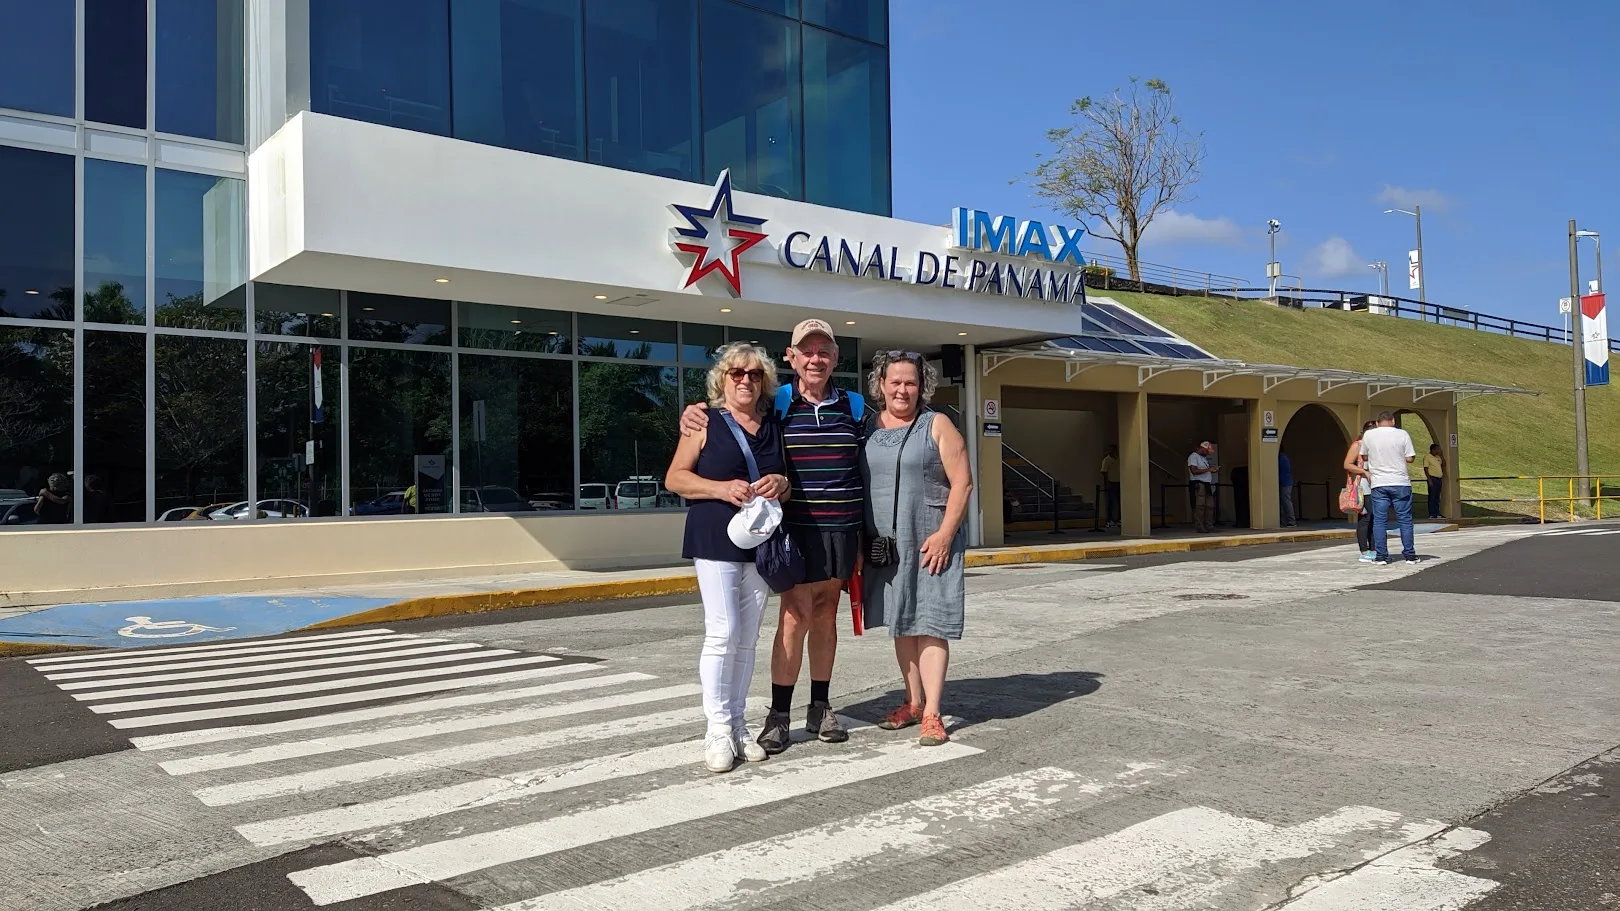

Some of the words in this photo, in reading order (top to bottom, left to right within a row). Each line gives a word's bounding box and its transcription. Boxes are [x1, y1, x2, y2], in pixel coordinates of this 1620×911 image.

[783, 230, 903, 281] CANAL
[914, 250, 960, 289] DE
[967, 258, 1088, 305] PANAMÁ
[952, 206, 1087, 266] IMAX
